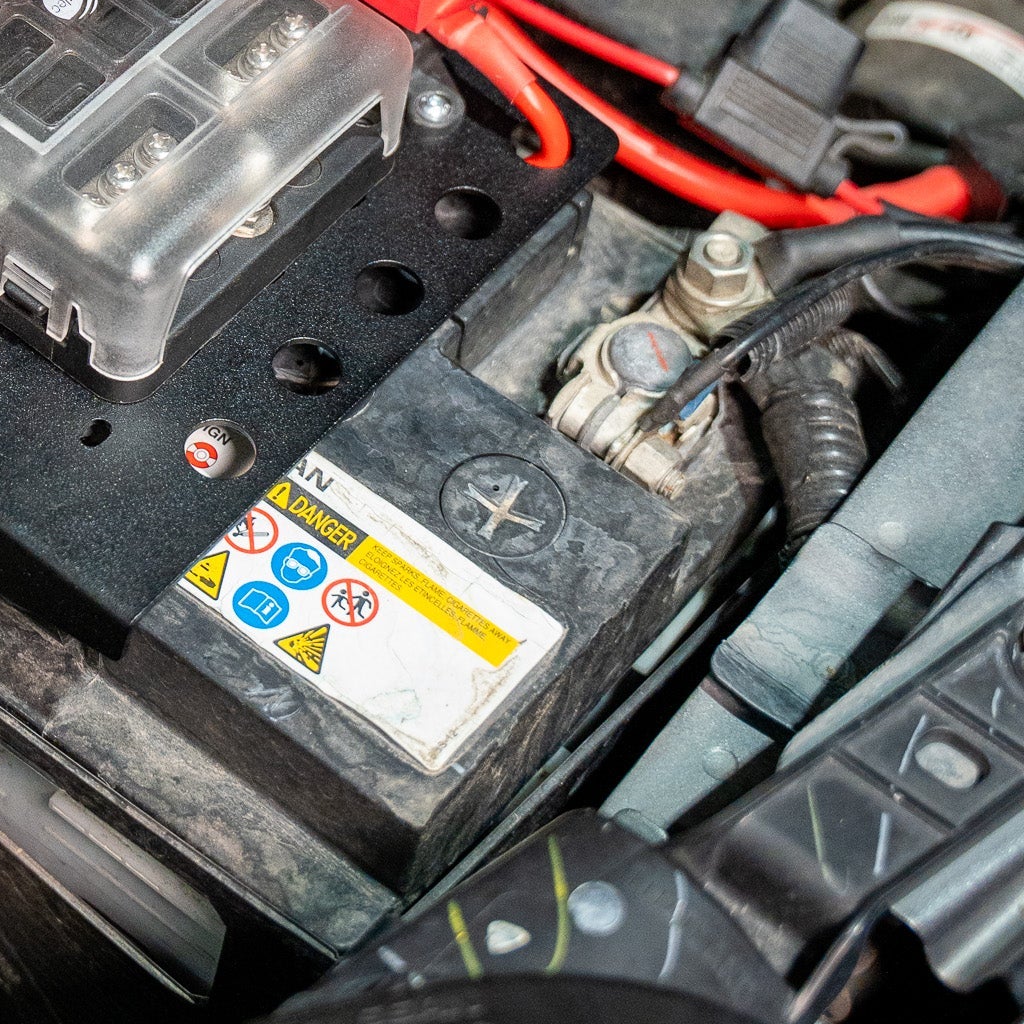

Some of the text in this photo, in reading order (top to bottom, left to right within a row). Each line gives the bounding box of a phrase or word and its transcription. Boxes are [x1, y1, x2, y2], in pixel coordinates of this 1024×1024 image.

[287, 495, 357, 551] DANGER
[364, 550, 401, 579] ELOIGNEZ
[398, 574, 415, 589] LES
[371, 543, 392, 560] KEEP
[444, 595, 491, 630] CIGARETTES
[488, 626, 512, 645] AWAY
